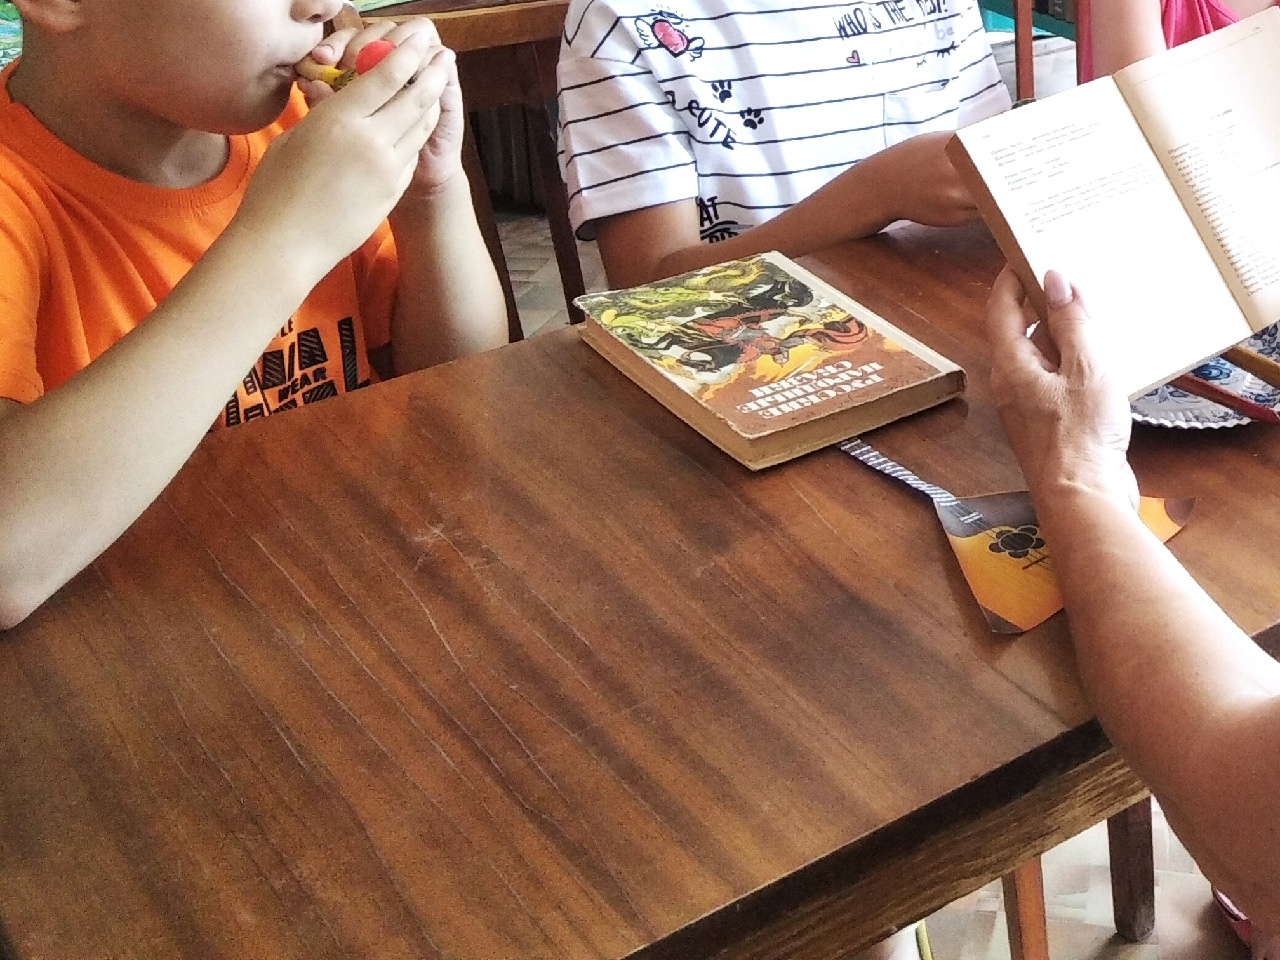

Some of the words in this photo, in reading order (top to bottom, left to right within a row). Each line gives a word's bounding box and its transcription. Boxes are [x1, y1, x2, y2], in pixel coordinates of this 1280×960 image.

[876, 0, 914, 25] THE
[278, 366, 328, 404] WEAR
[736, 362, 885, 414] НАРОДНЫЕ
[748, 360, 854, 398] СКАЗКИ
[758, 375, 886, 418] РУССКИЕ
